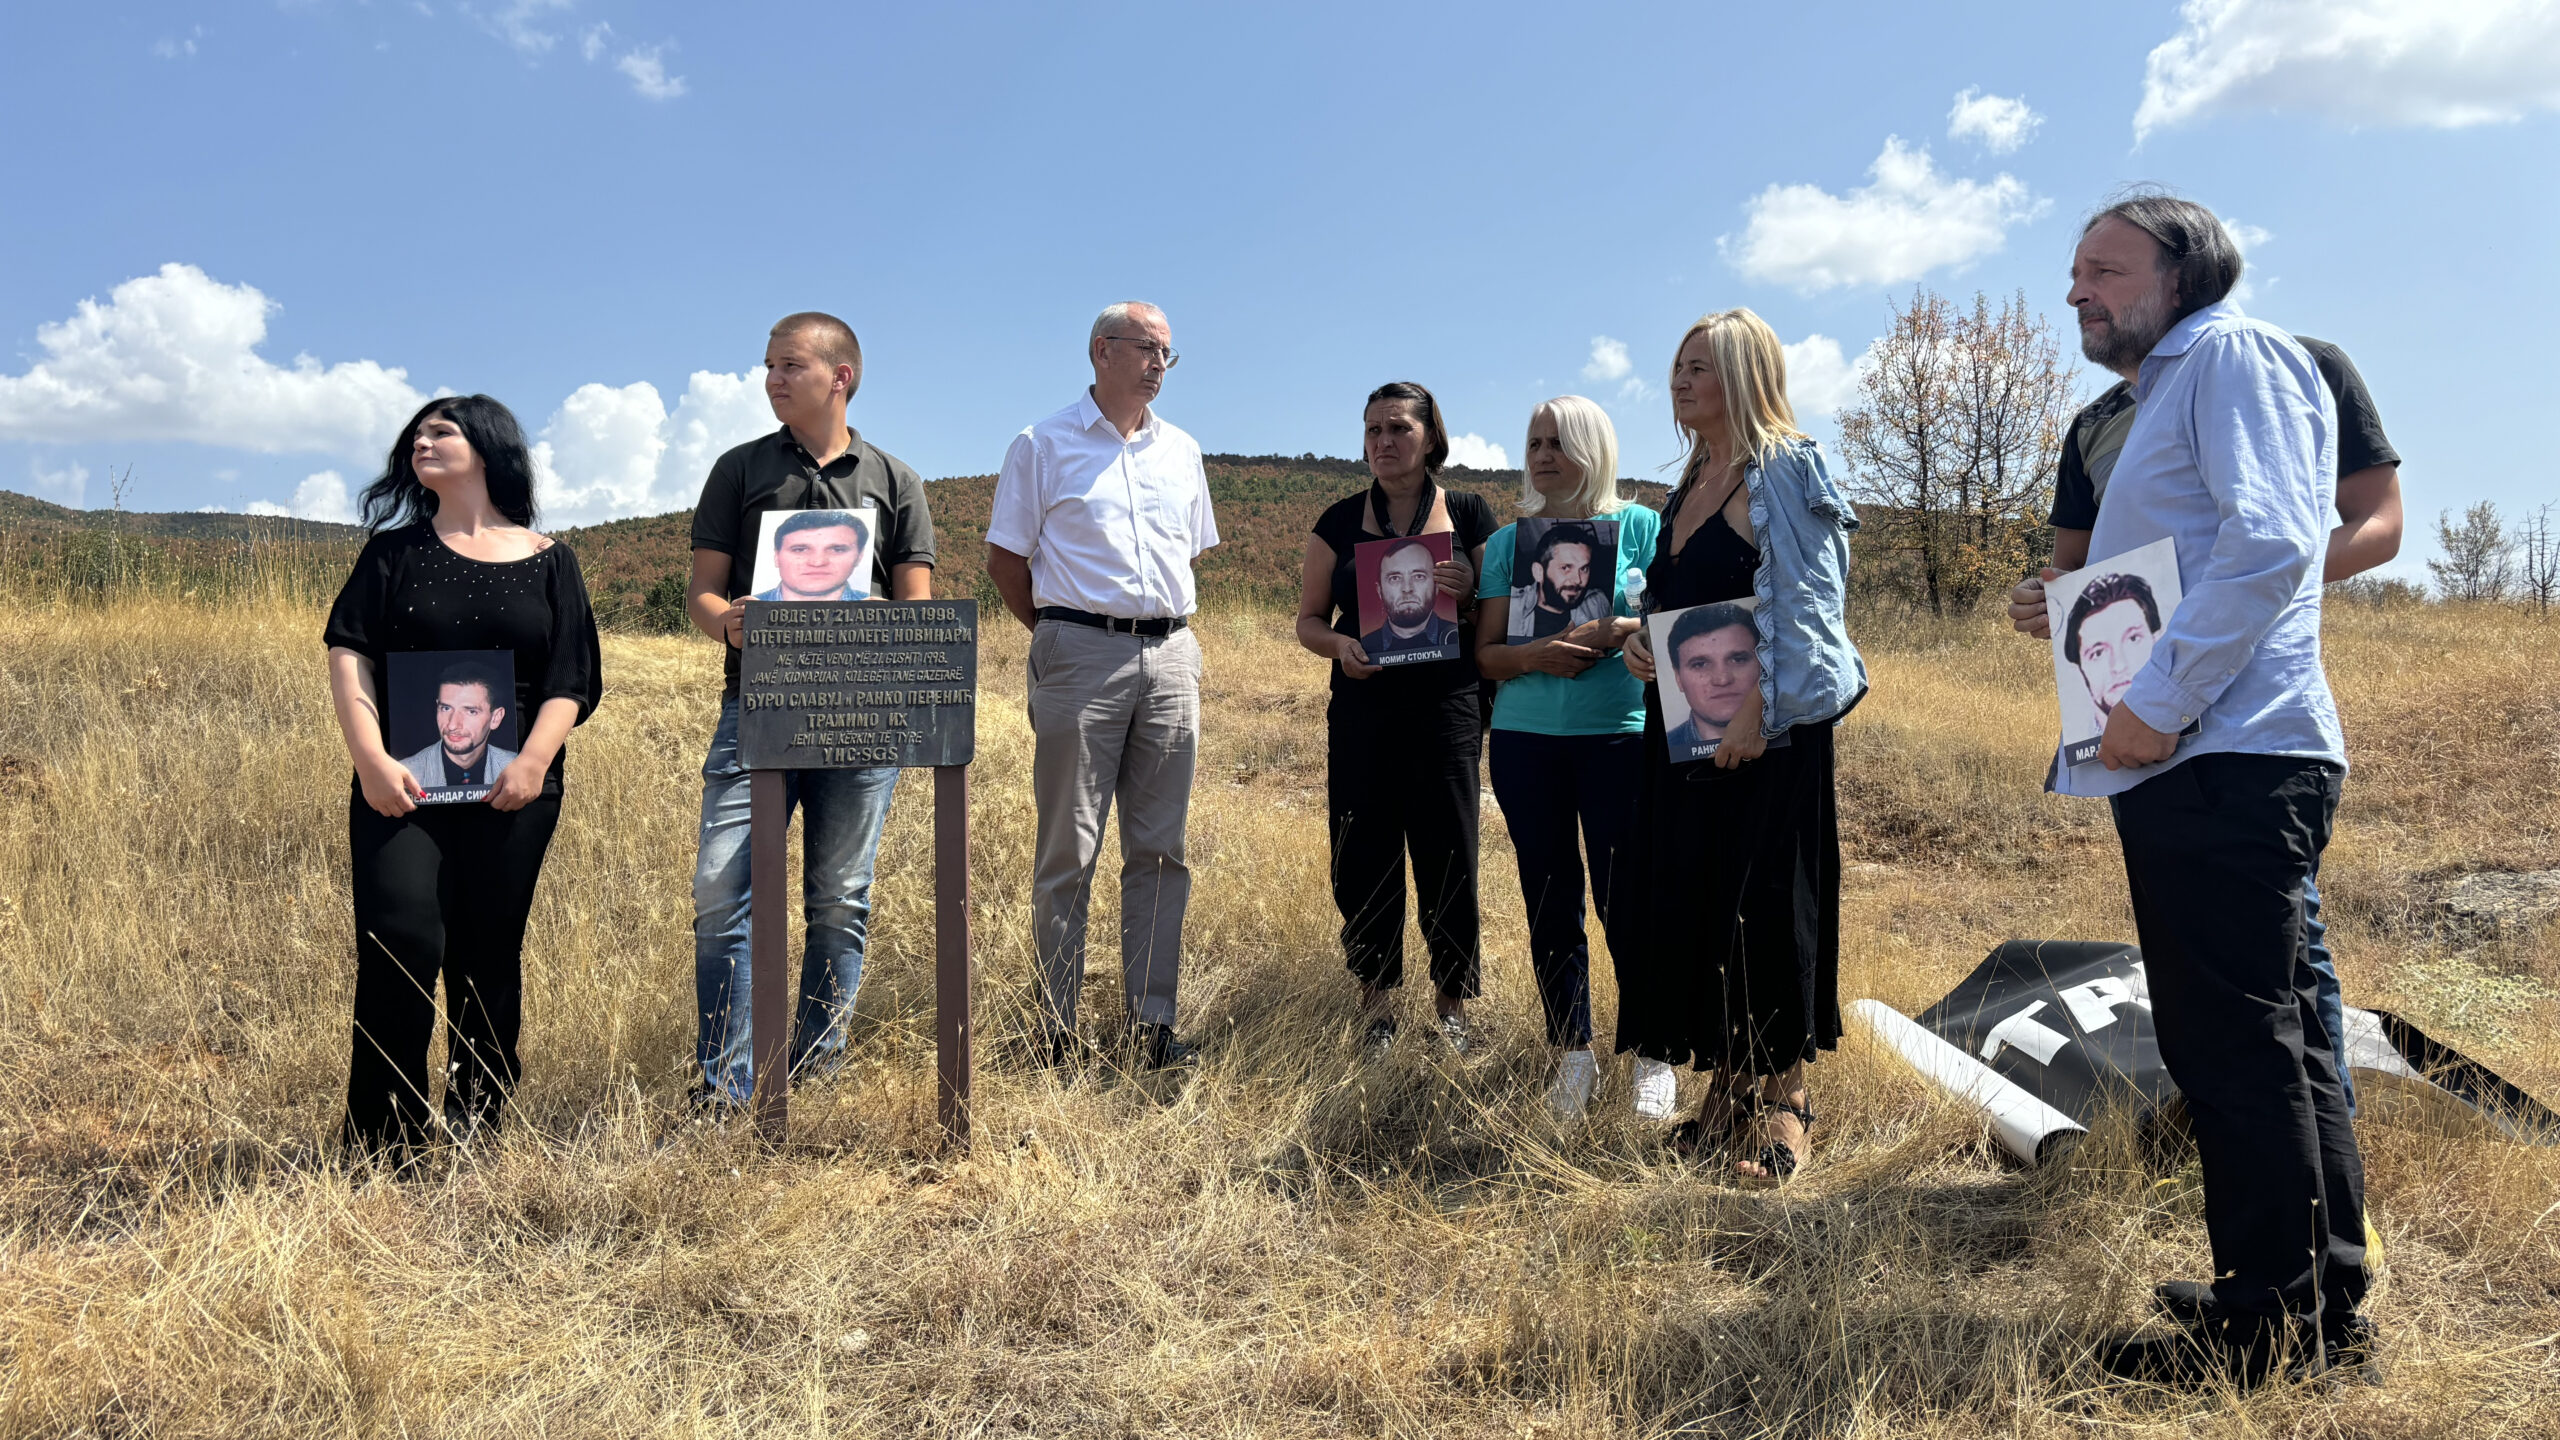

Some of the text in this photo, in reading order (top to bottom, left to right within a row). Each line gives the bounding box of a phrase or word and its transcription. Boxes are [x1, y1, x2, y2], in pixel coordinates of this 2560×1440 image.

[769, 608, 807, 623] ОВДЕ
[812, 608, 830, 623] СУ
[921, 606, 959, 621] 1998.
[750, 627, 973, 645] ОТЕТЕ НАШЕ КОЛЕГЕ НОВИНАРИ
[1379, 650, 1443, 665] МОМИР СТОКУЋА
[751, 669, 778, 684] JANË
[783, 670, 839, 684] KIDNAPUAR
[745, 692, 785, 710] ЂУРО
[789, 691, 842, 707] СЛАВУЈ
[856, 690, 903, 707] РАНКО
[907, 688, 974, 706] ПЕРЕНИЋ
[807, 711, 909, 729] ТРАЖИМО ИХ
[792, 732, 815, 748] JEMI
[896, 730, 924, 744] TYRE
